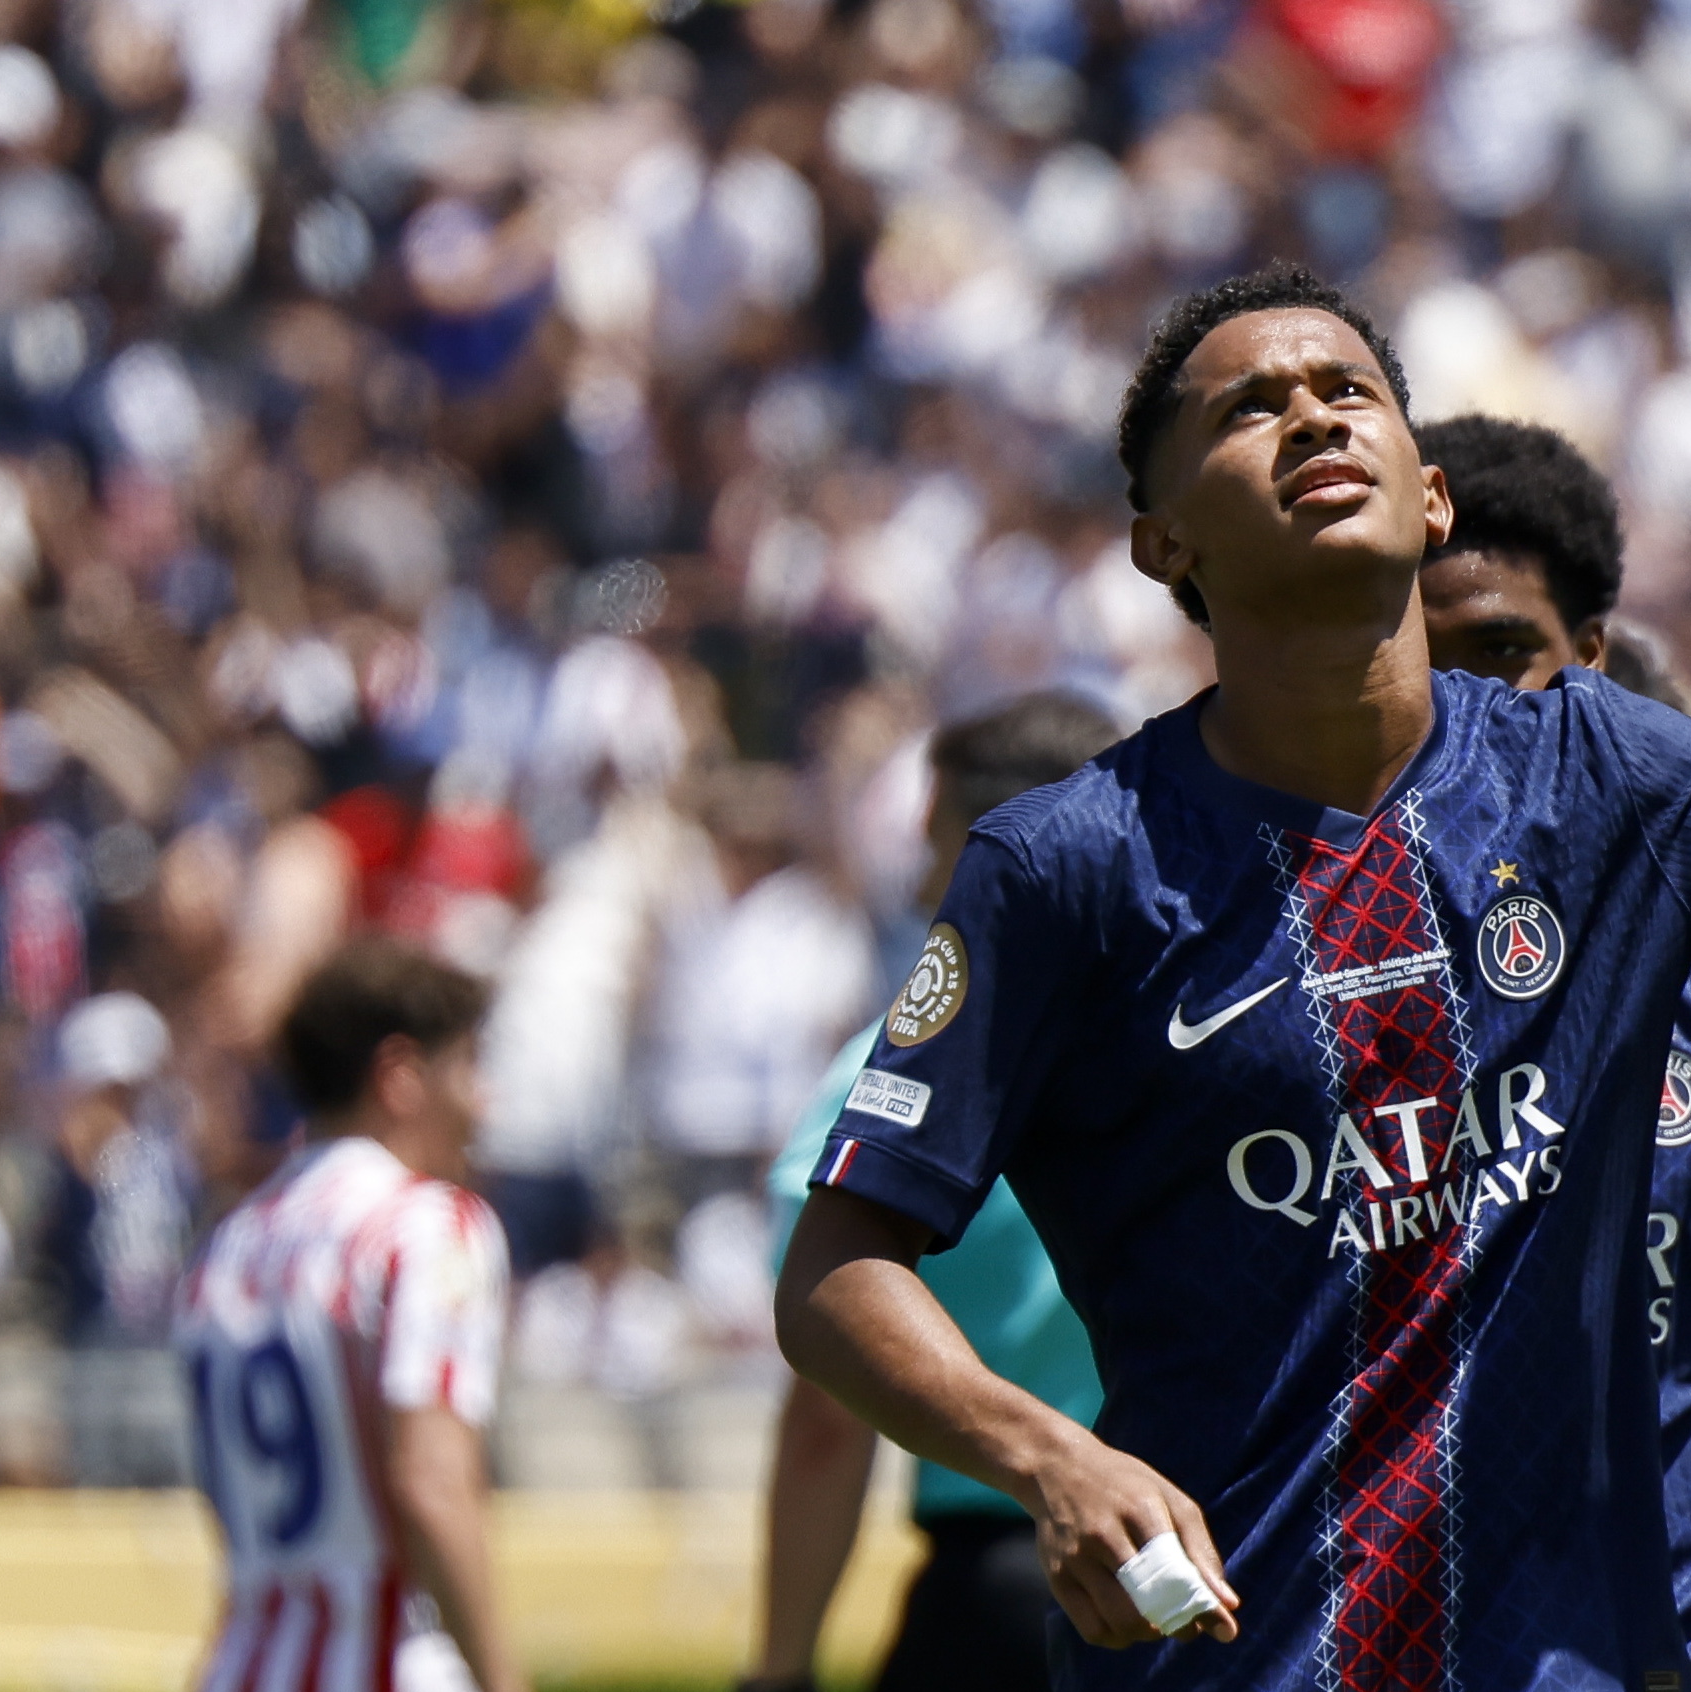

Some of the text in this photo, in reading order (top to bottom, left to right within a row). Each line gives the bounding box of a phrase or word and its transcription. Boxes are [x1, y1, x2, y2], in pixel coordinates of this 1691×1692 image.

[1486, 901, 1541, 932] PARIS
[940, 941, 958, 965] CUP
[947, 970, 959, 990] 25
[1497, 974, 1520, 987] SAINT
[1525, 959, 1554, 987] GERMAIN
[927, 994, 953, 1023] USA
[892, 1015, 920, 1037] FIFA
[888, 1081, 920, 1100] UNITES
[887, 1099, 911, 1116] FIFA
[1226, 1062, 1566, 1227] QATAR
[1327, 1144, 1562, 1259] AIRWAYS
[192, 1335, 323, 1546] 19
